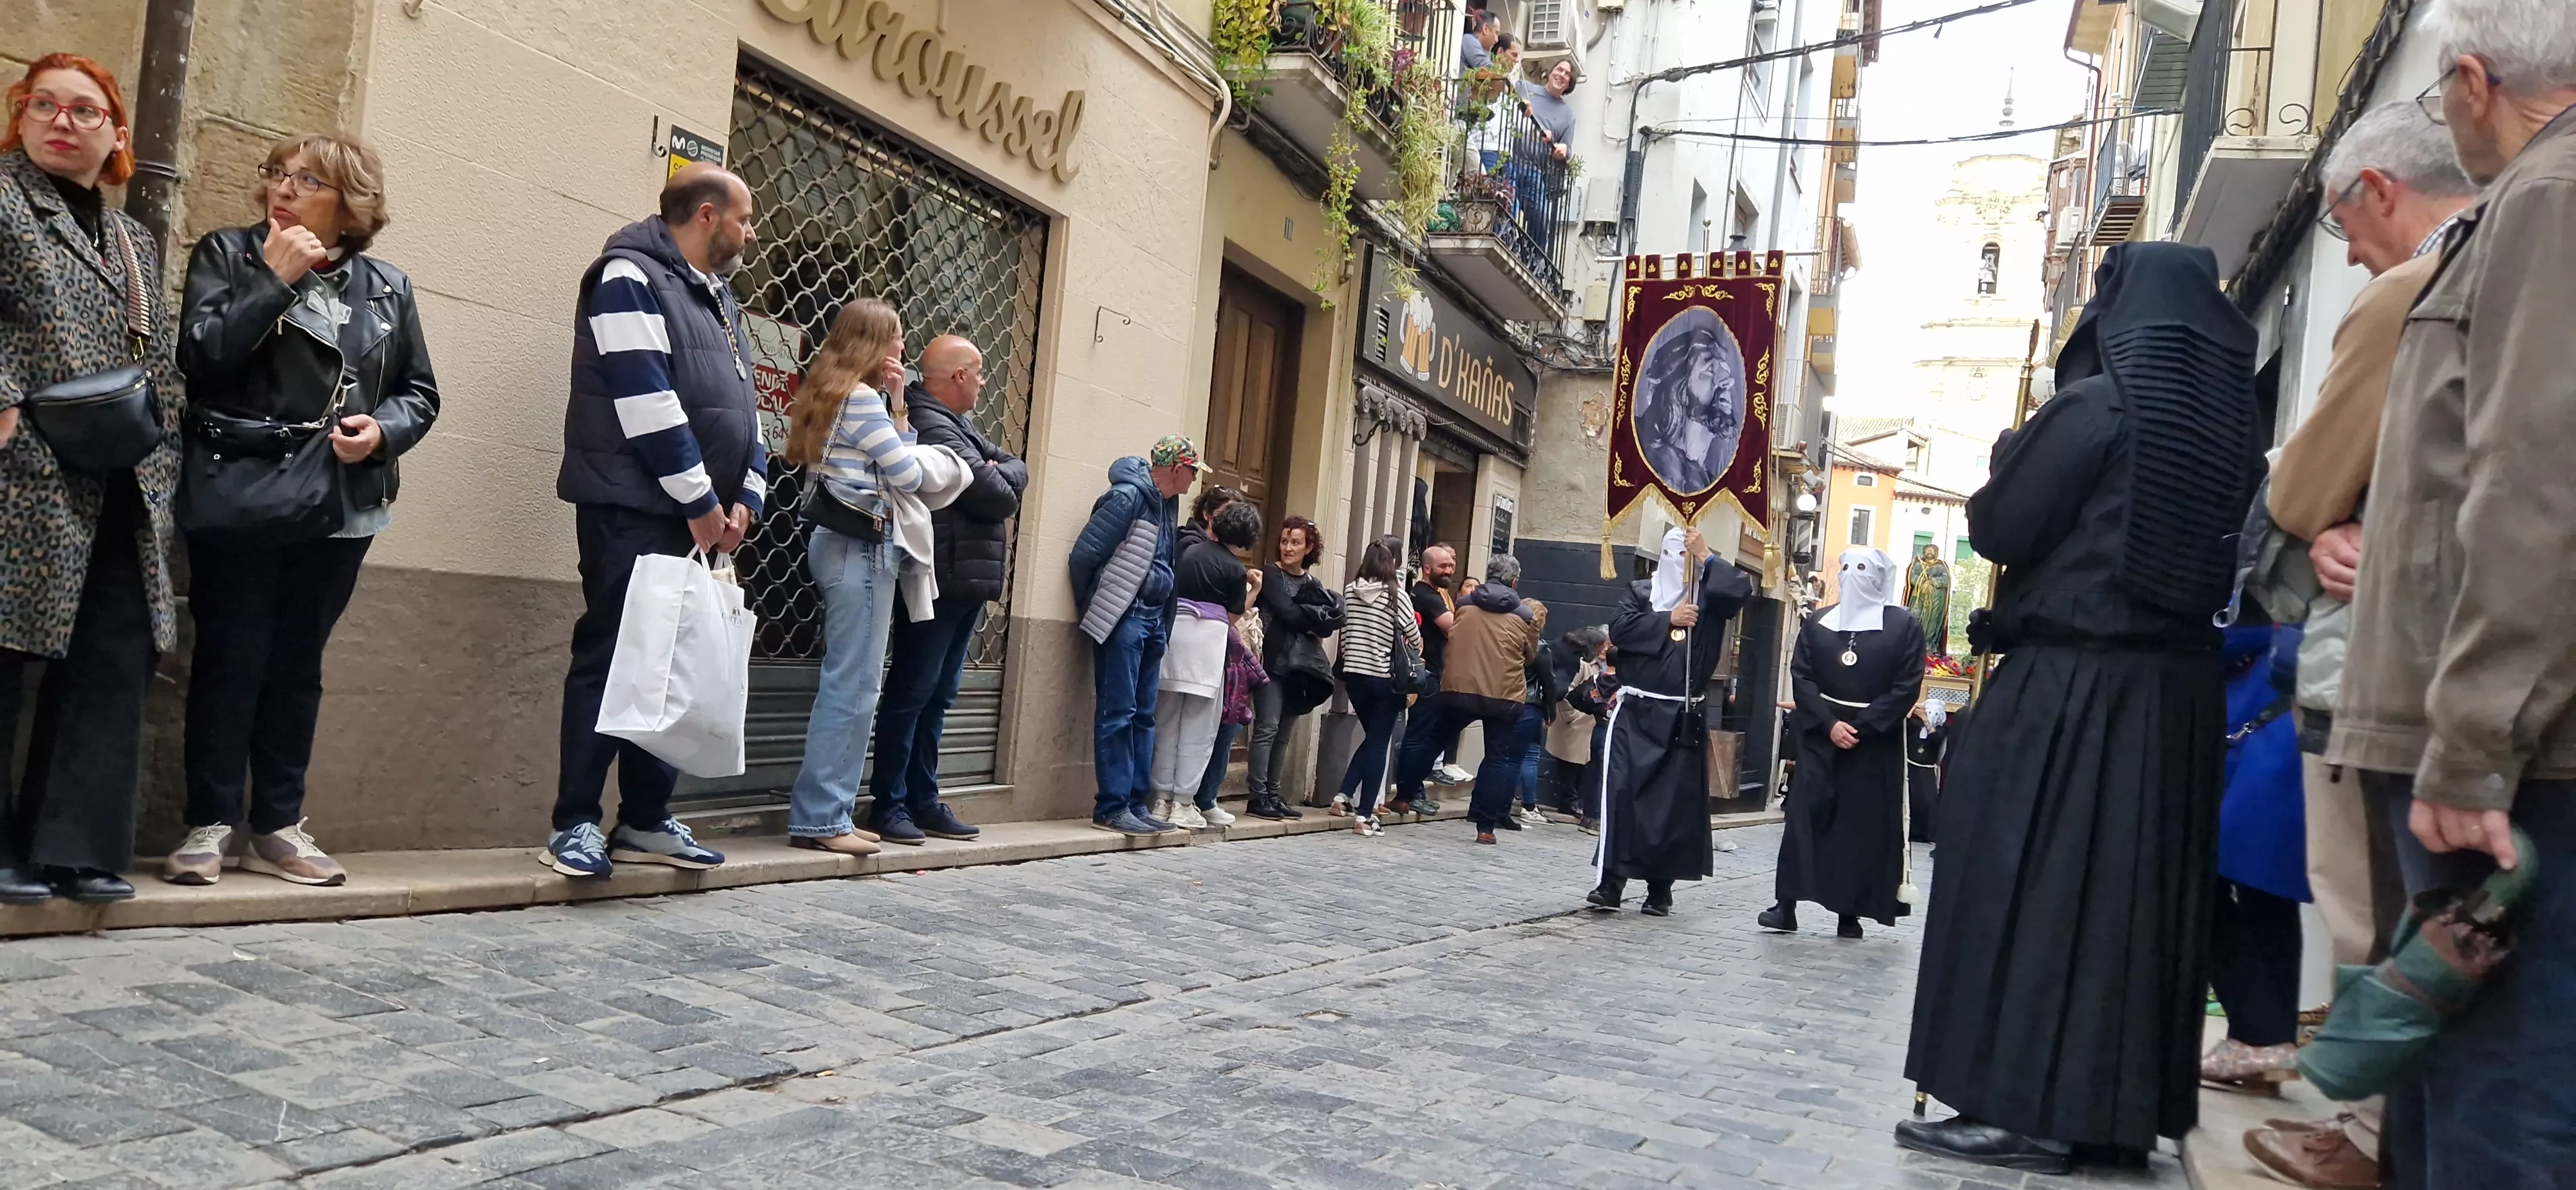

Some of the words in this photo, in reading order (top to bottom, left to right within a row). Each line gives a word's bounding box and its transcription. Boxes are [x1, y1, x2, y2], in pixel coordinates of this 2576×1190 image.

[754, 0, 1086, 183] aroussel
[754, 369, 789, 392] ENDE
[1438, 334, 1515, 426] D'KAÑAS
